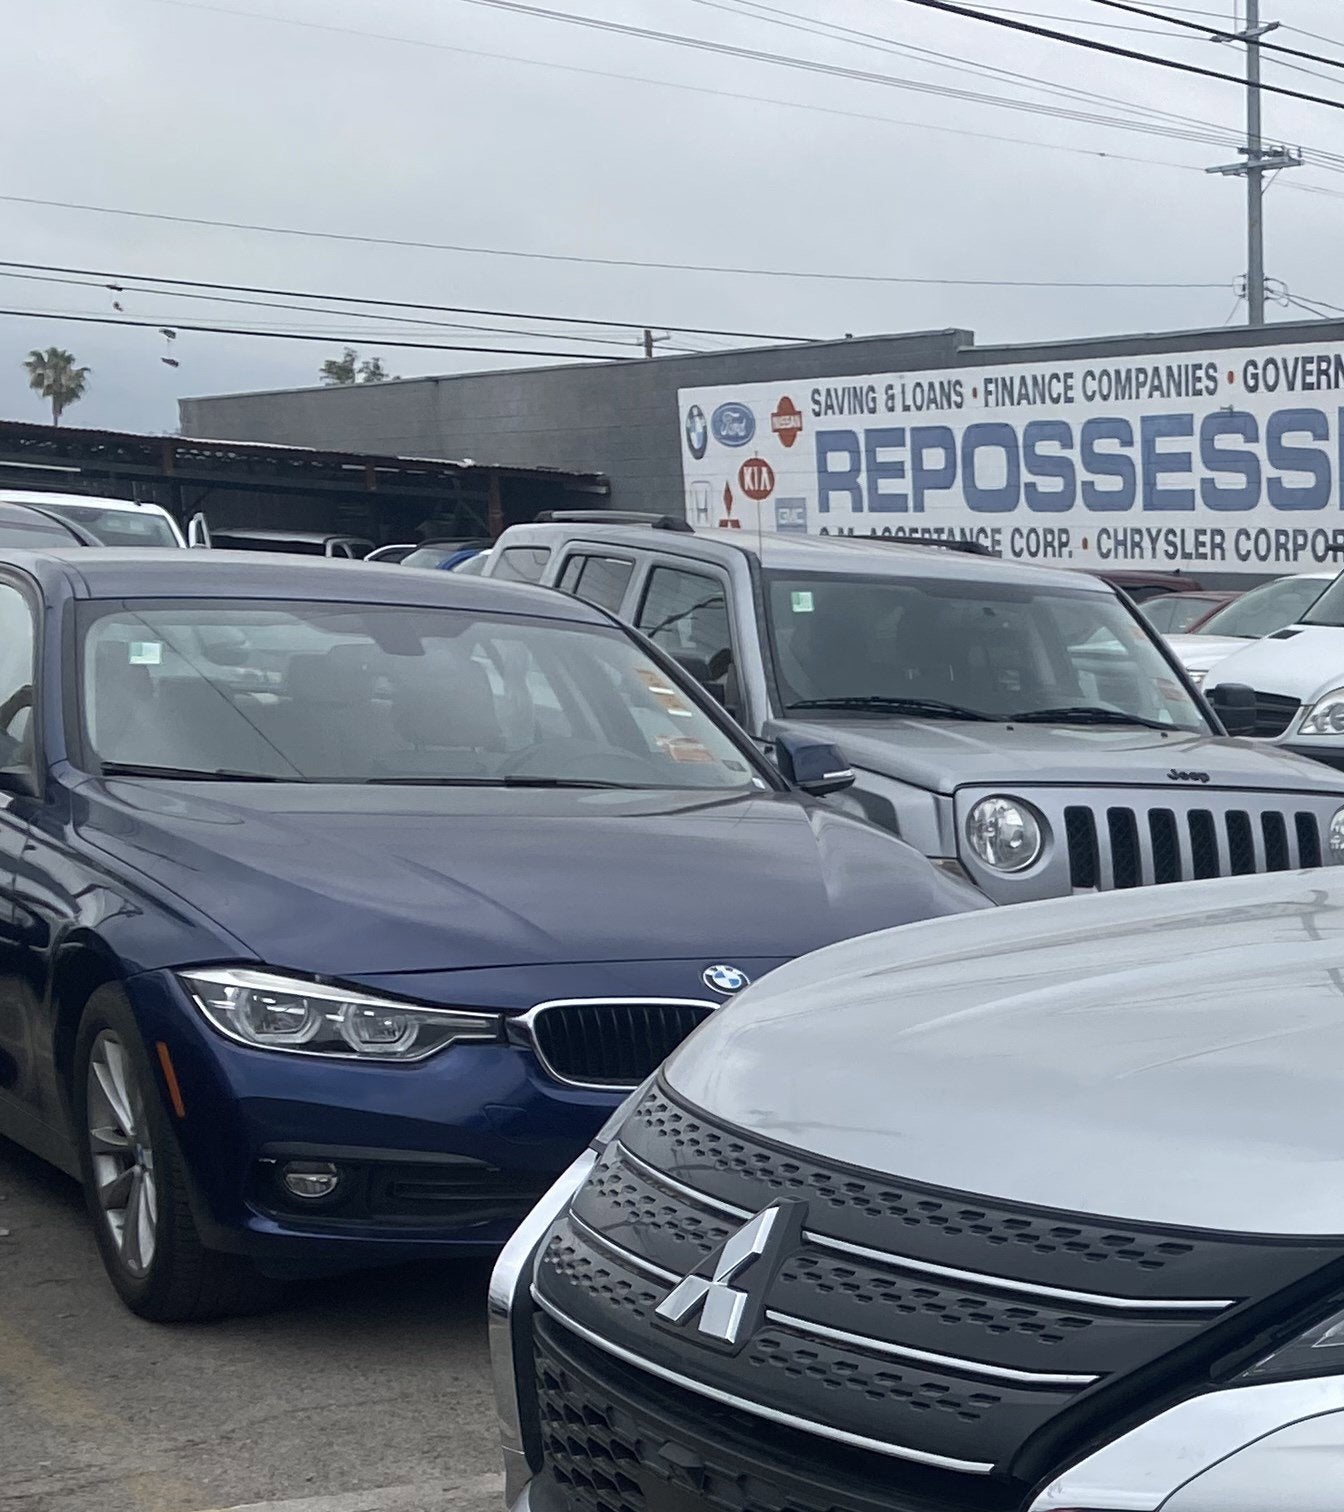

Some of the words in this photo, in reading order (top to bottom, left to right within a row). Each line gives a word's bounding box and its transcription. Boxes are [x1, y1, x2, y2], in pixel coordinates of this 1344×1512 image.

[811, 386, 878, 418] SAVING
[884, 383, 897, 412] &
[901, 379, 964, 411] LOANS
[984, 373, 1074, 408] FINANCE
[1082, 364, 1218, 403] COMPANIES
[743, 466, 771, 491] KIA
[1011, 527, 1072, 558] CORP.
[1096, 527, 1226, 561] CHRYSLER
